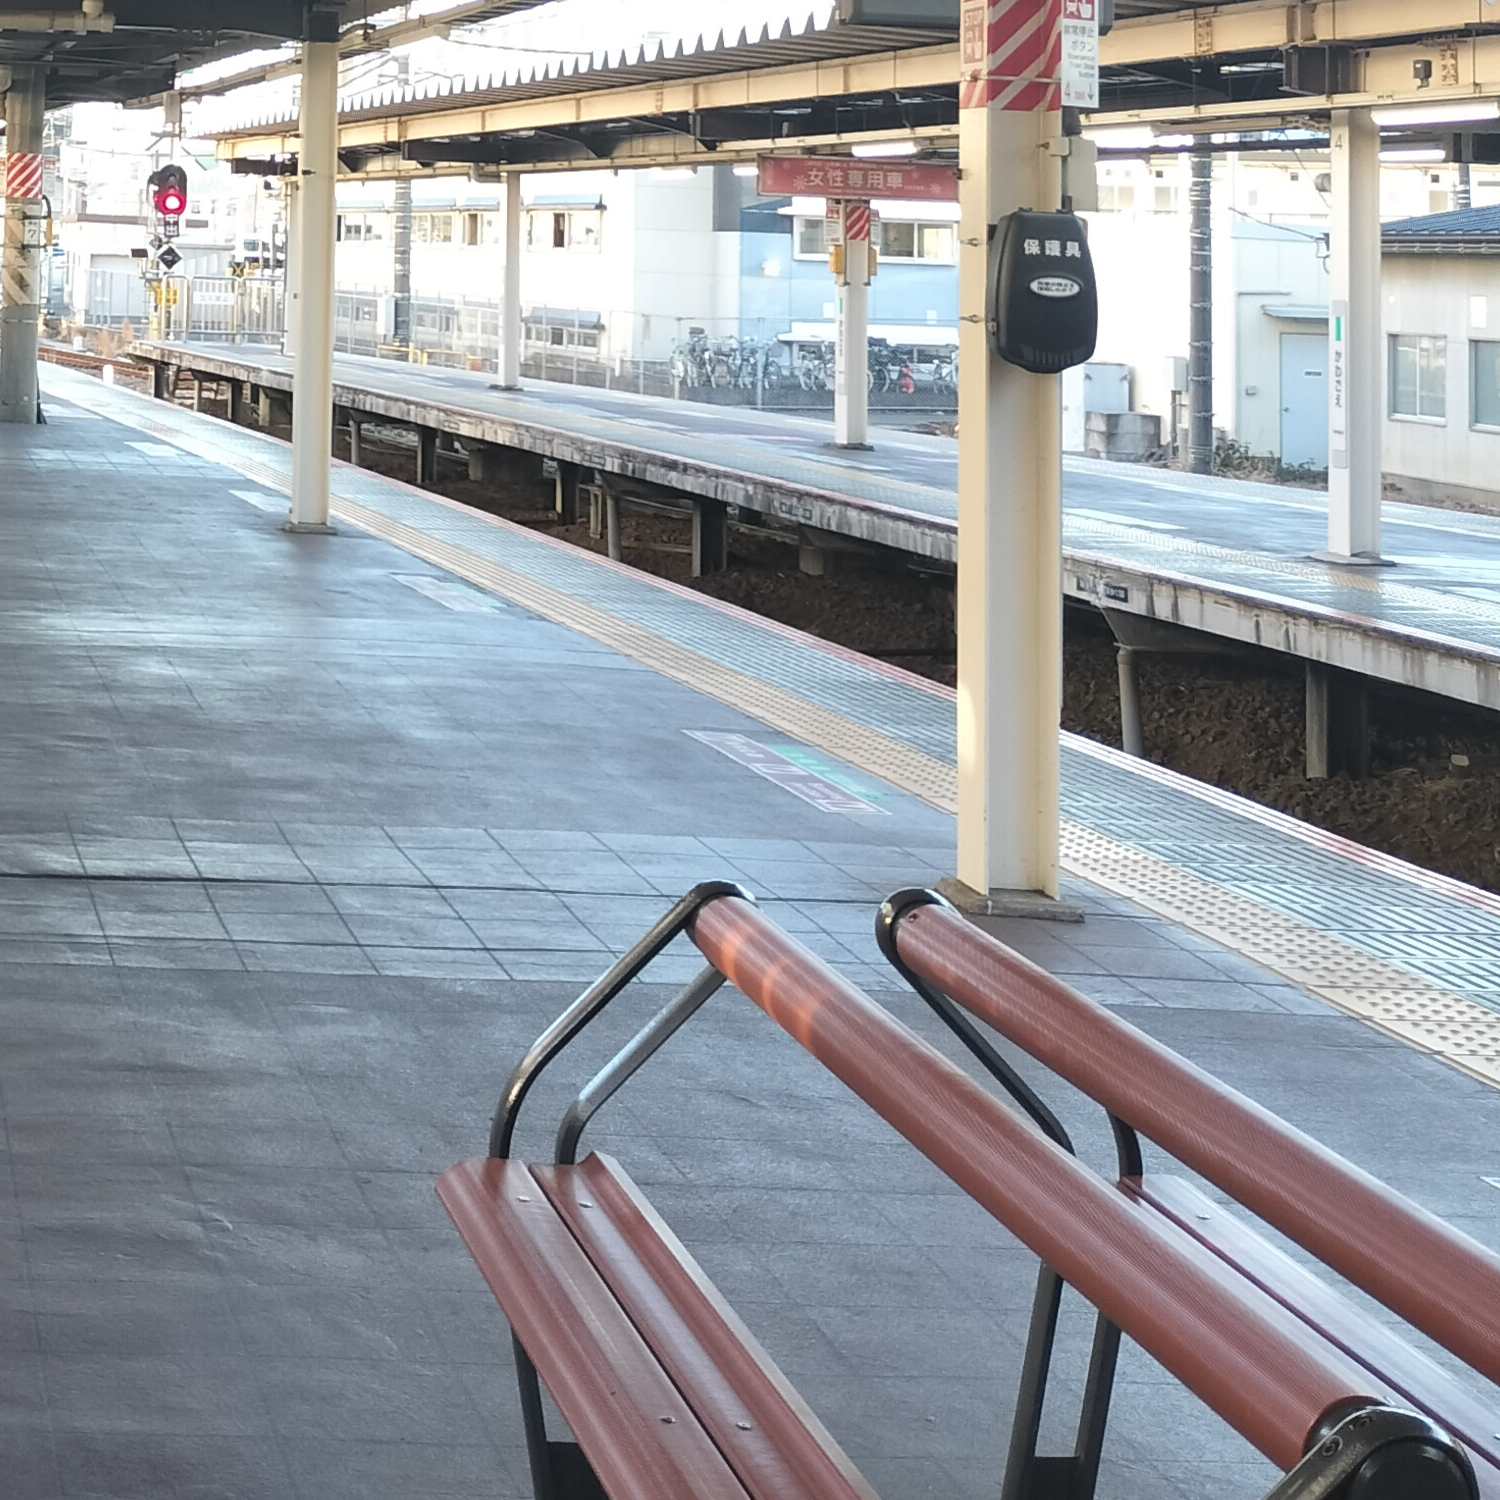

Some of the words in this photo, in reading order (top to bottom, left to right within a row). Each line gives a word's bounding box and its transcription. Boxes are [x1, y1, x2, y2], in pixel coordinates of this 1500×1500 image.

[964, 10, 983, 26] STOP
[1334, 134, 1342, 150] 4
[807, 168, 903, 190] 女性専用車
[1024, 238, 1081, 258] 保護具
